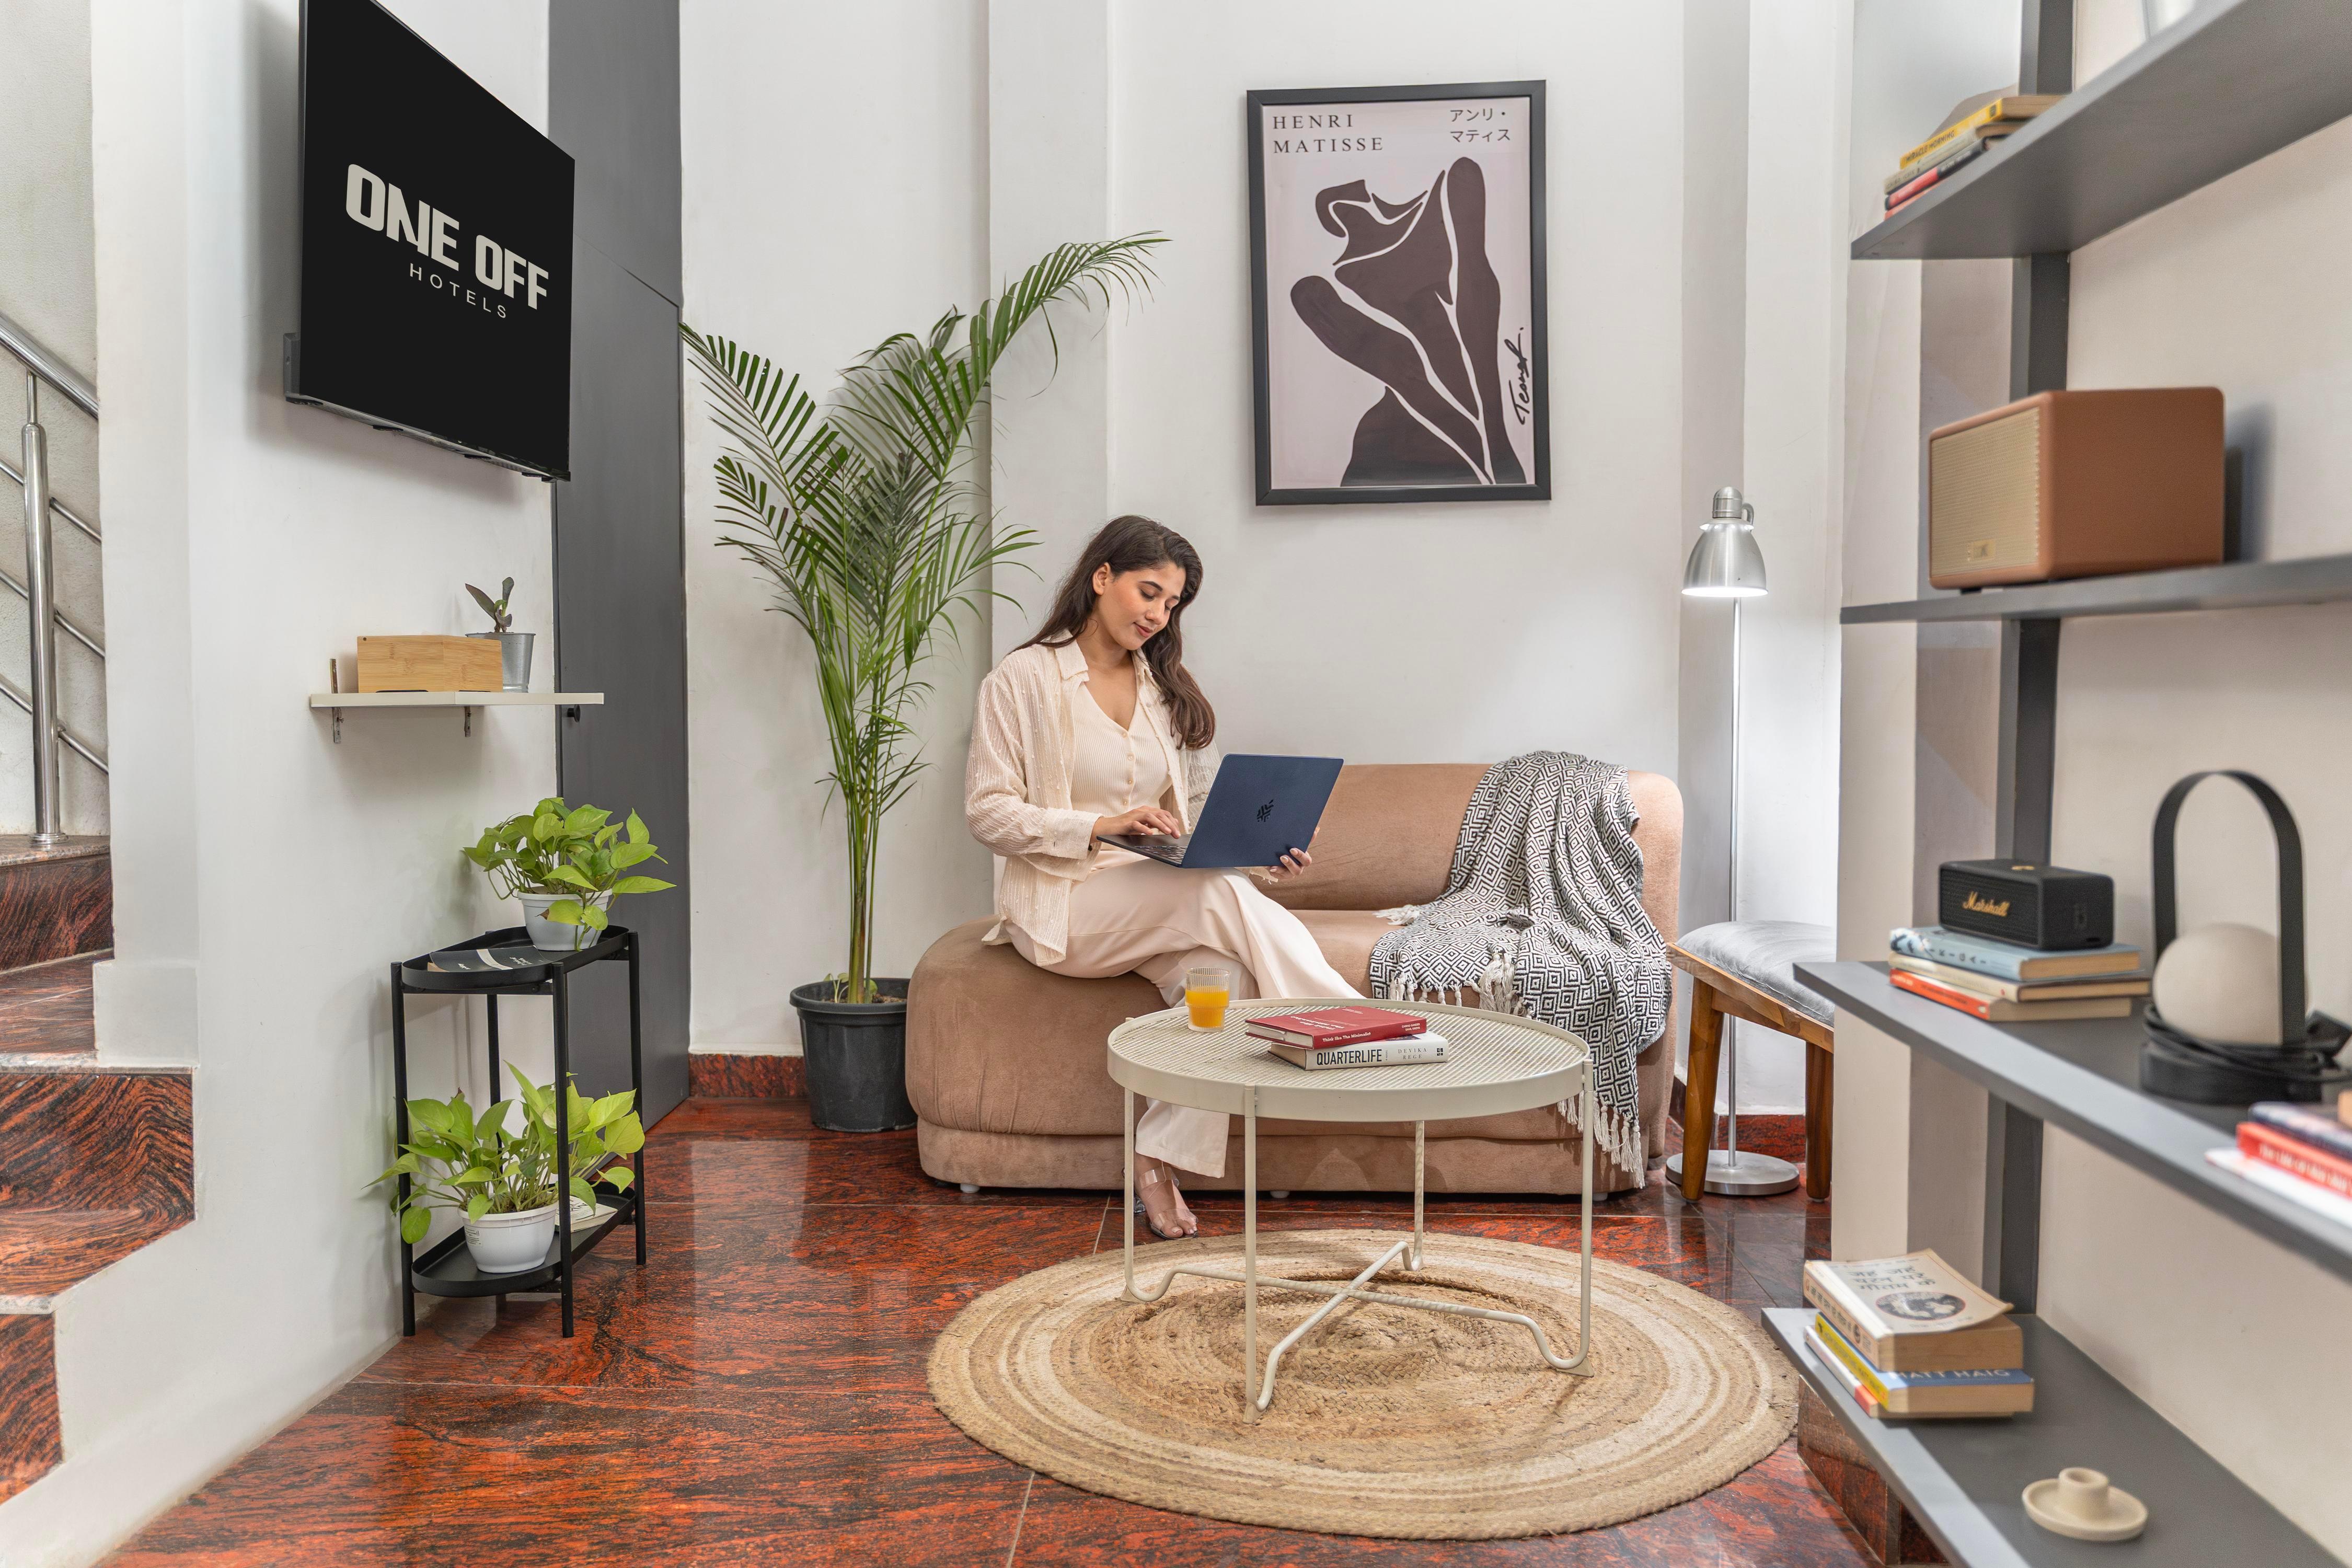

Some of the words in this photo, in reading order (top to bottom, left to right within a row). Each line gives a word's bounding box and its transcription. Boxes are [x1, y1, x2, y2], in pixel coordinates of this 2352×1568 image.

[1272, 114, 1354, 130] HENRI
[1450, 129, 1511, 142] マティス
[1273, 137, 1383, 154] MATISSE
[1906, 145, 1928, 163] MIRACLE
[1929, 130, 1955, 149] MORNING
[345, 164, 459, 271] ONE
[475, 234, 549, 310] OFF
[410, 262, 506, 318] HOTELS
[1962, 891, 2010, 917] Marshall
[1929, 948, 1987, 964] IKIGAI
[1317, 1049, 1382, 1065] QUARTERLIFE
